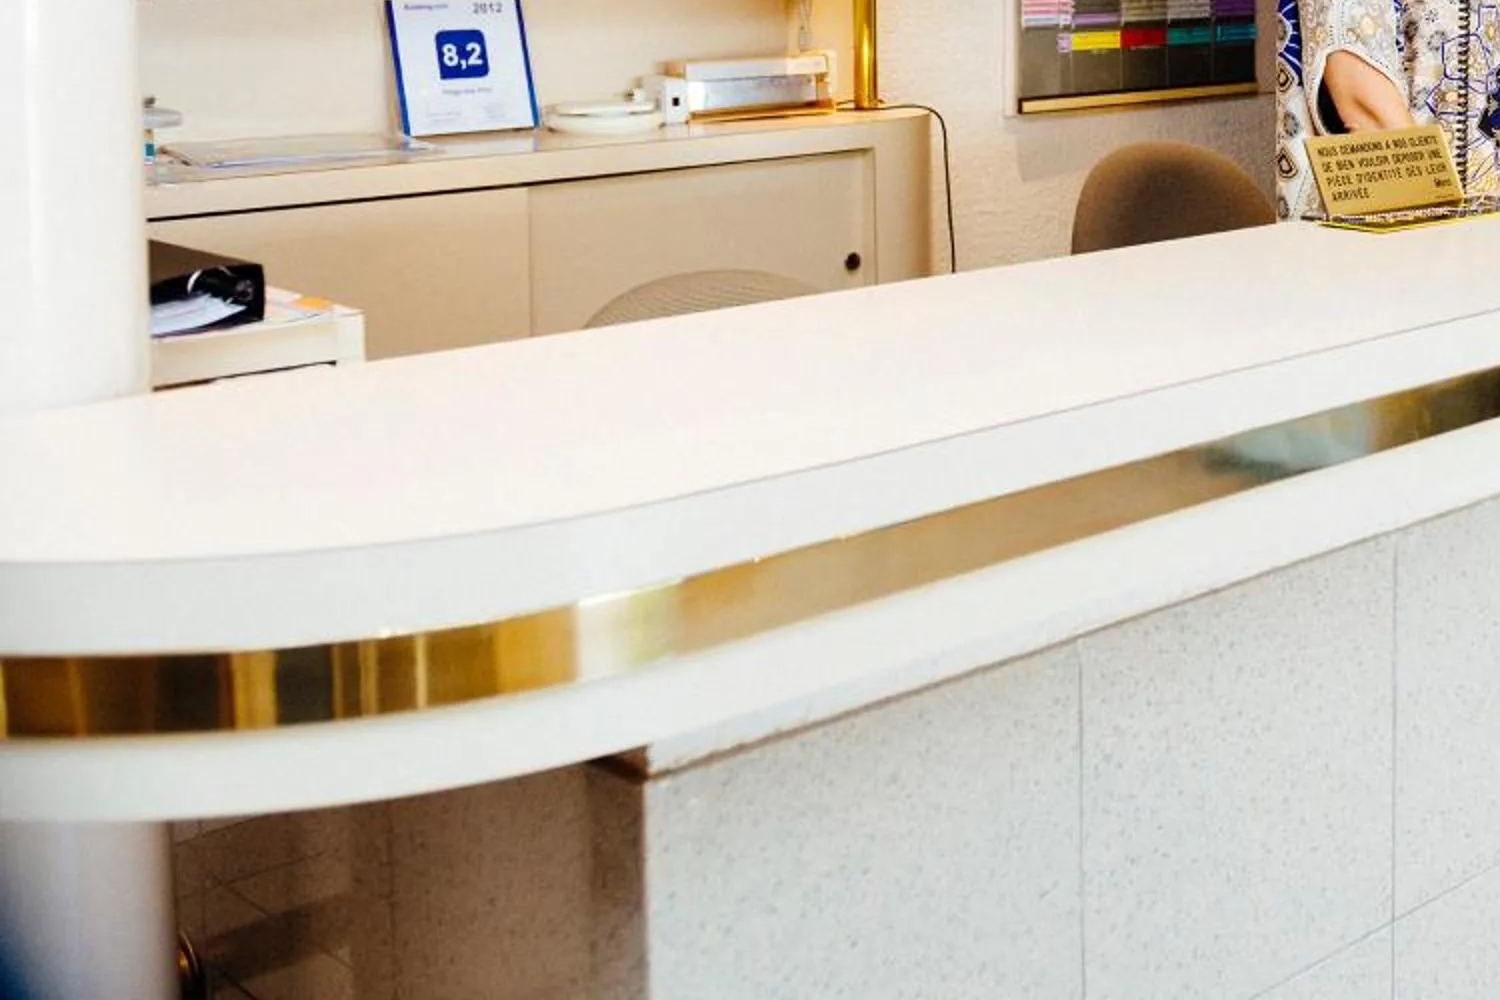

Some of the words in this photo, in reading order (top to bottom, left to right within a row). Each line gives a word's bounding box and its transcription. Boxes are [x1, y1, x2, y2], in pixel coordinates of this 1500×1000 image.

[472, 2, 503, 14] 2012
[442, 41, 484, 70] 8,2
[1317, 144, 1339, 157] NOUS
[1322, 160, 1334, 173] DE
[1359, 154, 1390, 168] VOULOIR
